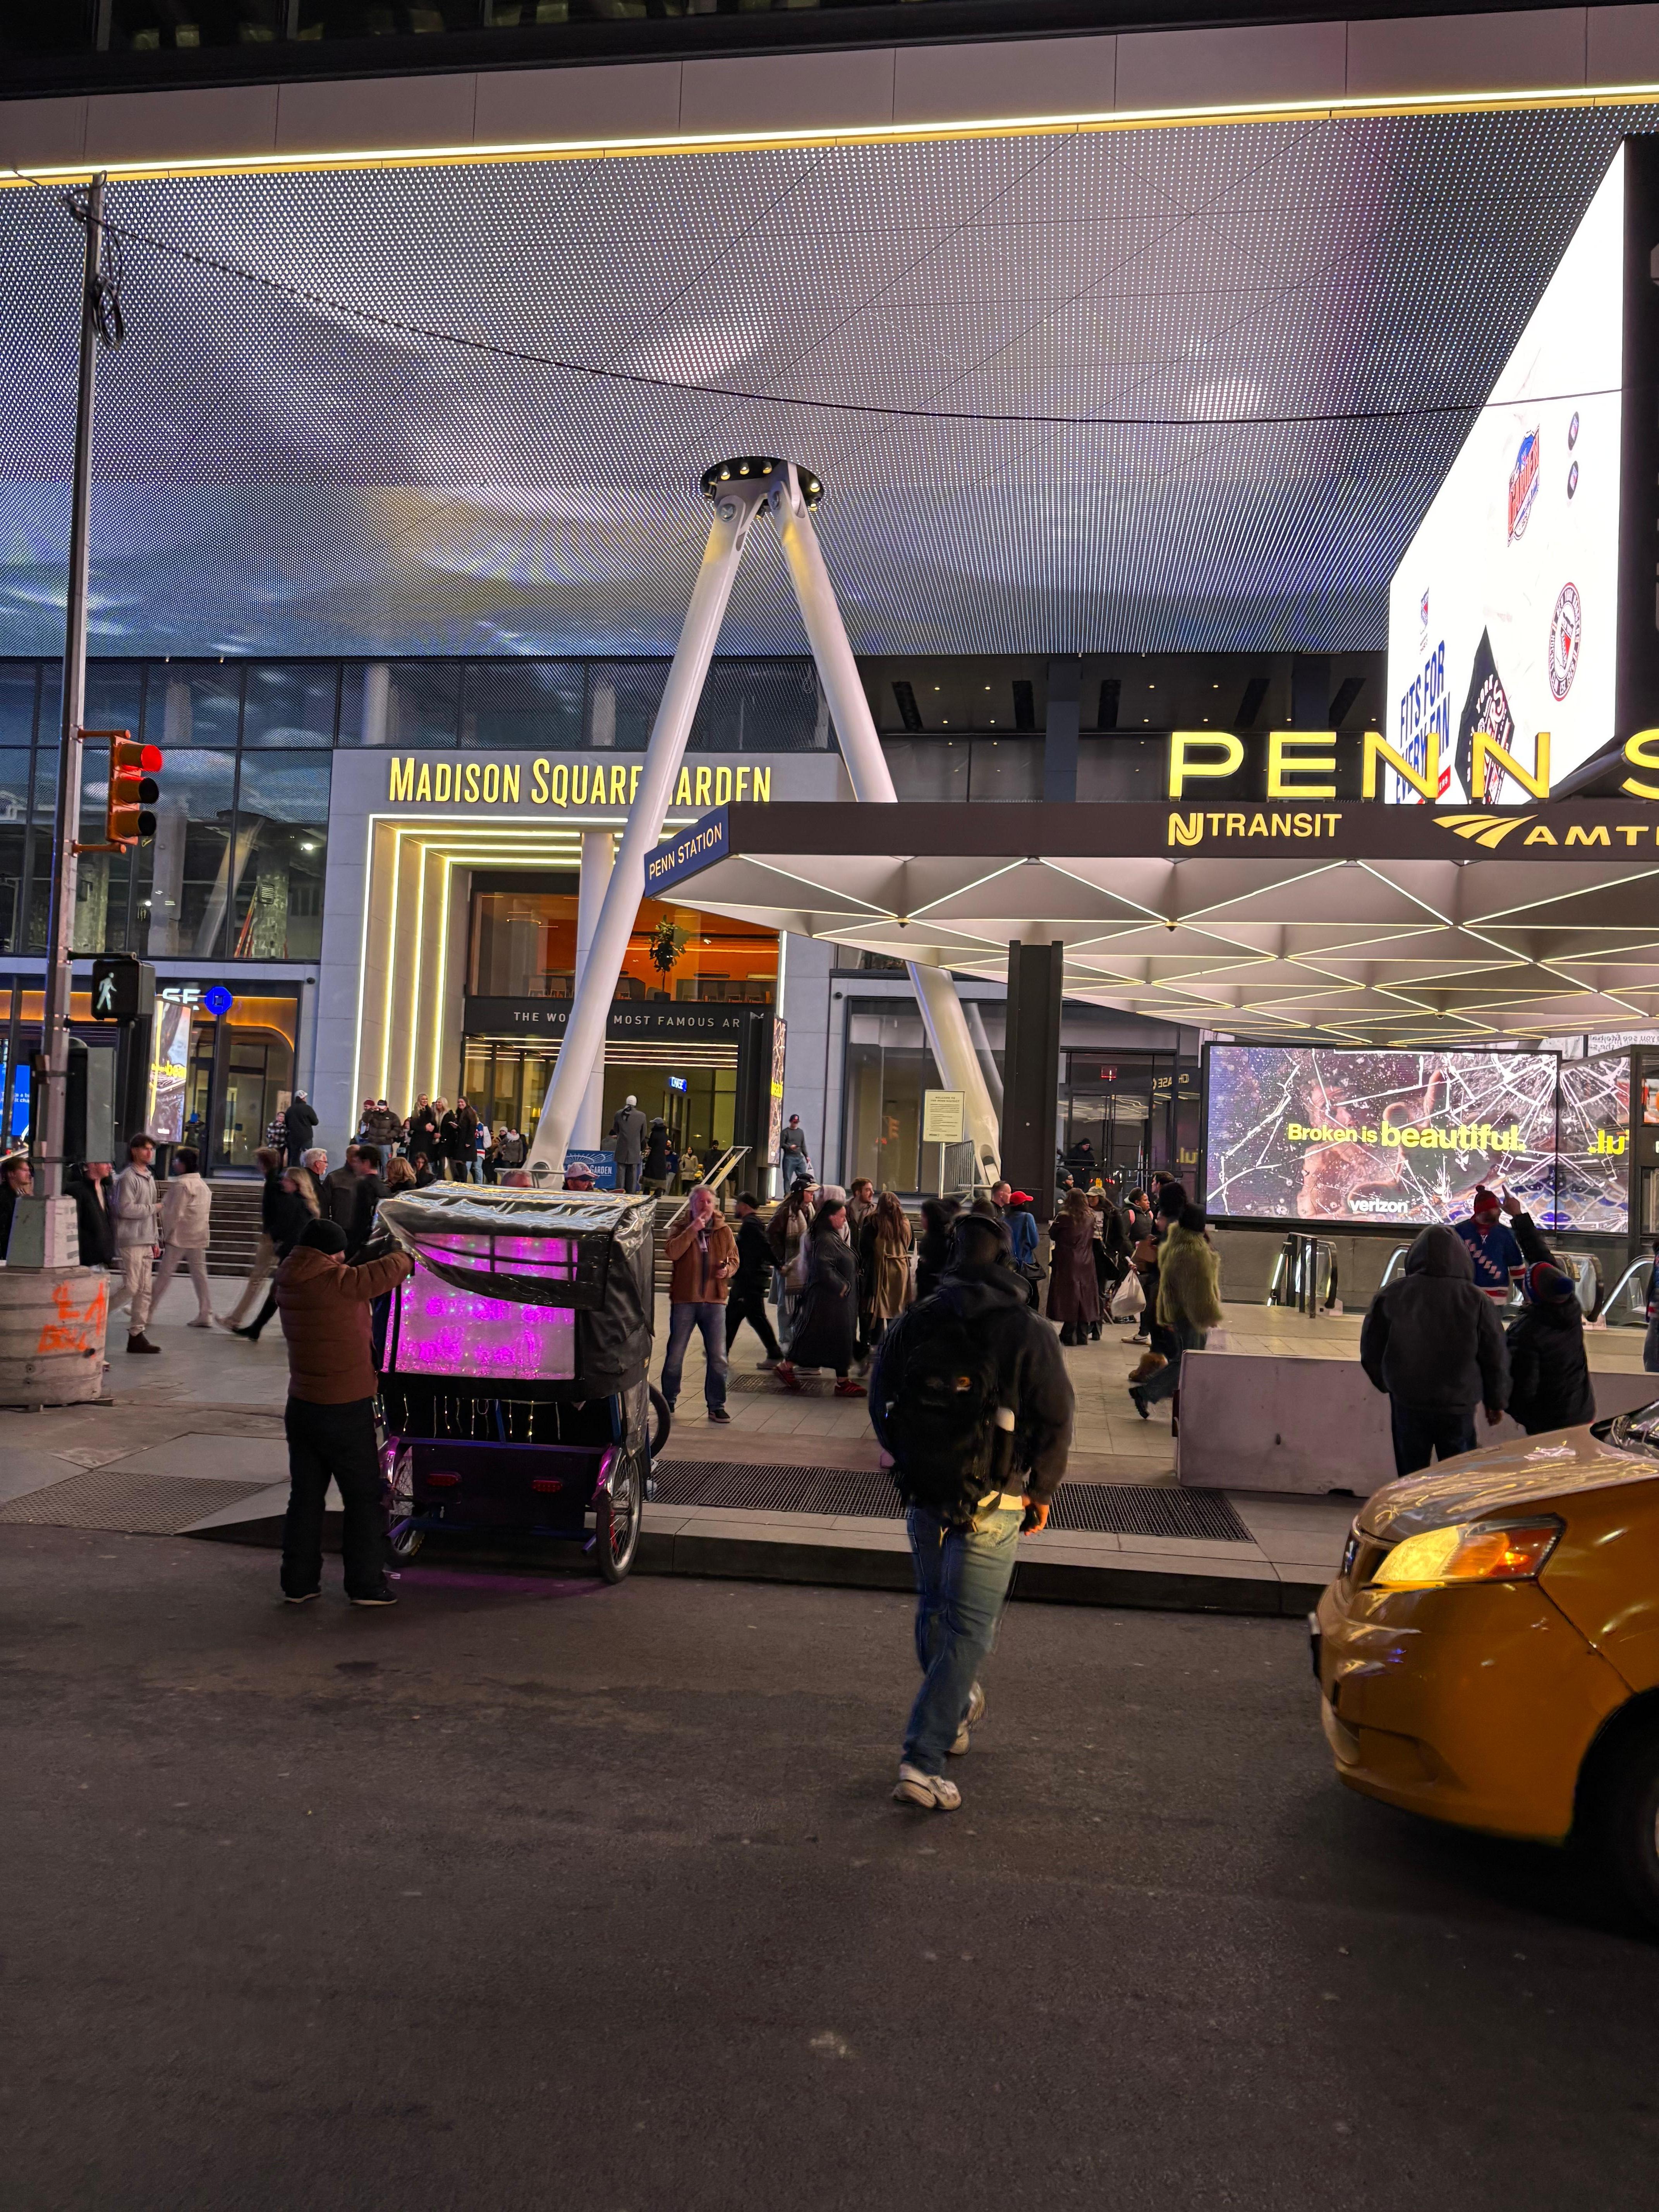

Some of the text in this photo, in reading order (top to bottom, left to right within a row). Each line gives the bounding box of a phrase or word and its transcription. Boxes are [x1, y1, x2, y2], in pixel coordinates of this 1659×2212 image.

[1400, 640, 1444, 749] FITS FOR
[1168, 731, 1550, 799] PENN
[390, 757, 771, 808] MADISON SQUARE ARDEN
[1206, 813, 1342, 837] TRANSIT
[1523, 826, 1659, 846] AMT
[649, 822, 722, 880] PENN STATION
[514, 1012, 539, 1022] THE
[614, 1015, 651, 1025] MOST
[658, 1016, 714, 1027] FAMOUS
[1288, 1120, 1527, 1151] Broken is beautiful.
[1350, 1198, 1408, 1213] verizon
